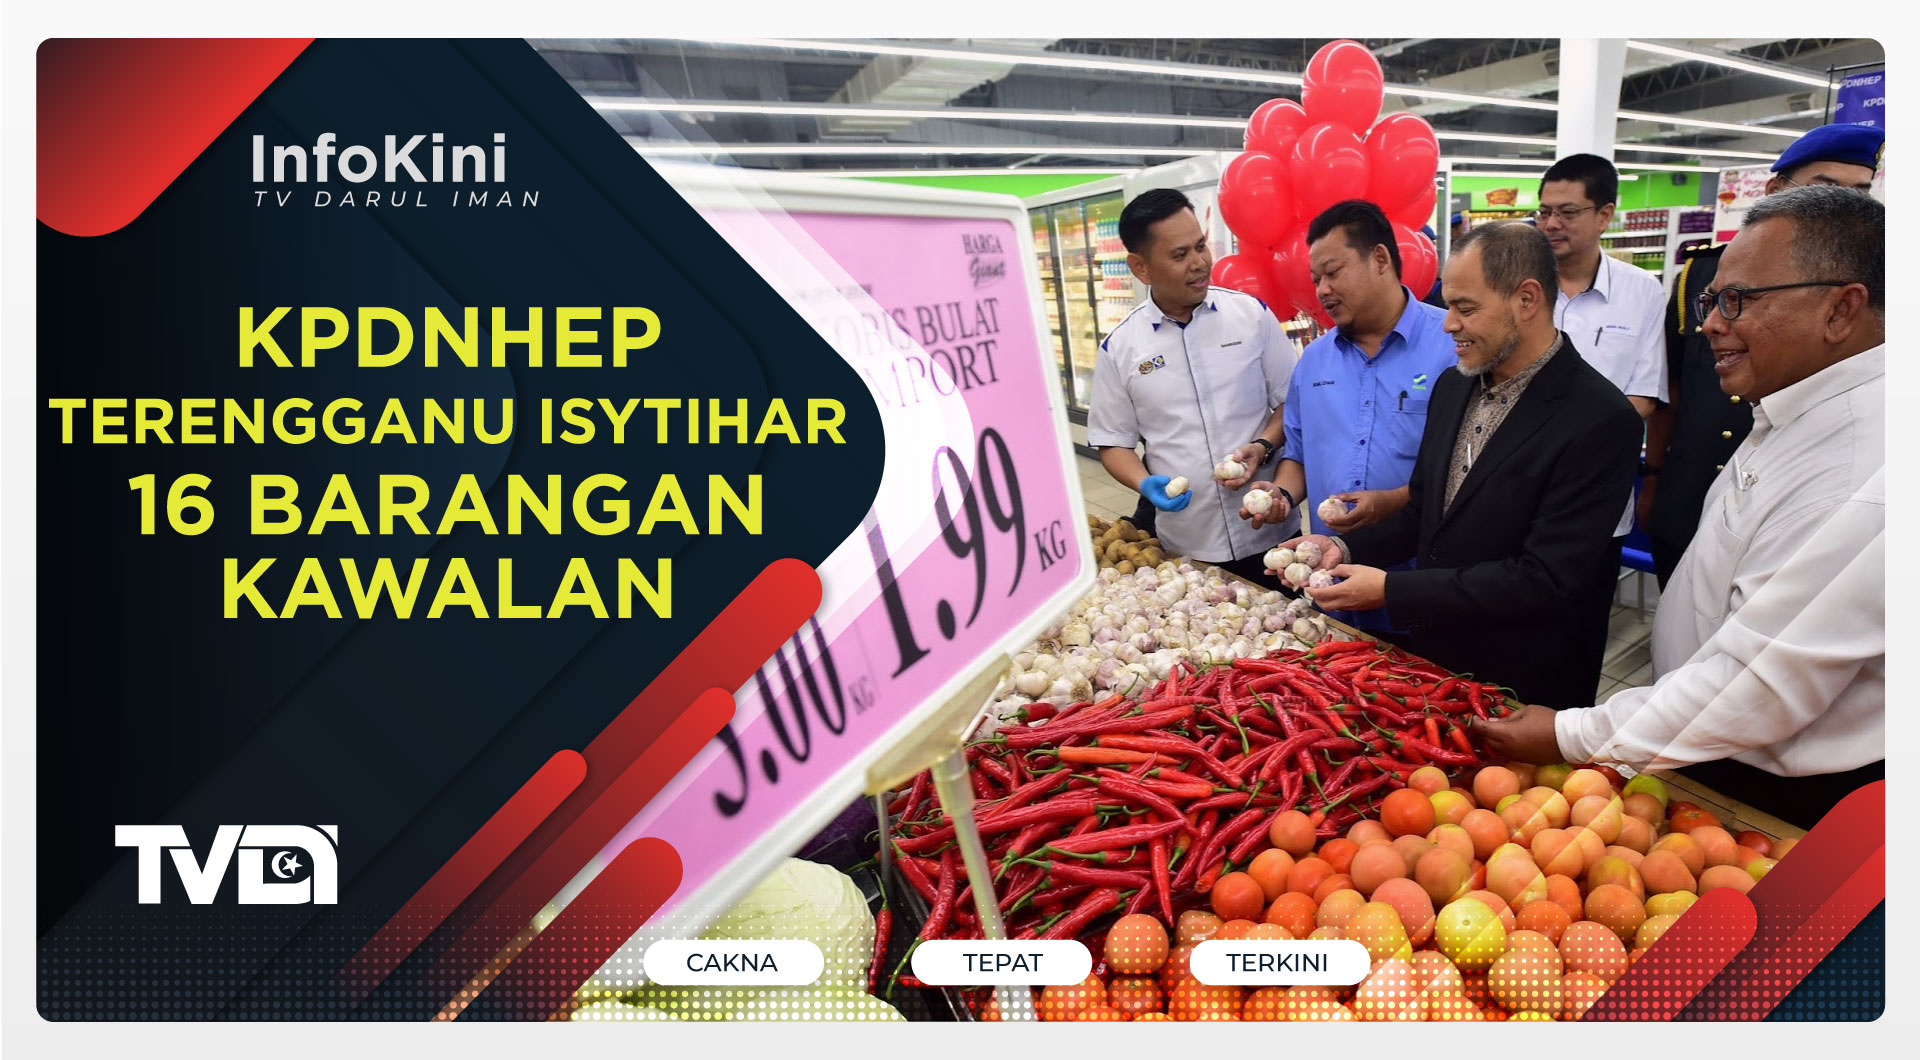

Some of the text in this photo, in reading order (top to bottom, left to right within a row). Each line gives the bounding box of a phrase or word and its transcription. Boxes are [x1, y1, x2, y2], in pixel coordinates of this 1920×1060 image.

[1863, 97, 1885, 108] KPD
[962, 233, 1003, 254] HARGA
[970, 256, 1005, 288] Giant
[915, 298, 1000, 346] BULAT
[862, 427, 1068, 680] 1.99 KG
[848, 674, 875, 716] KG
